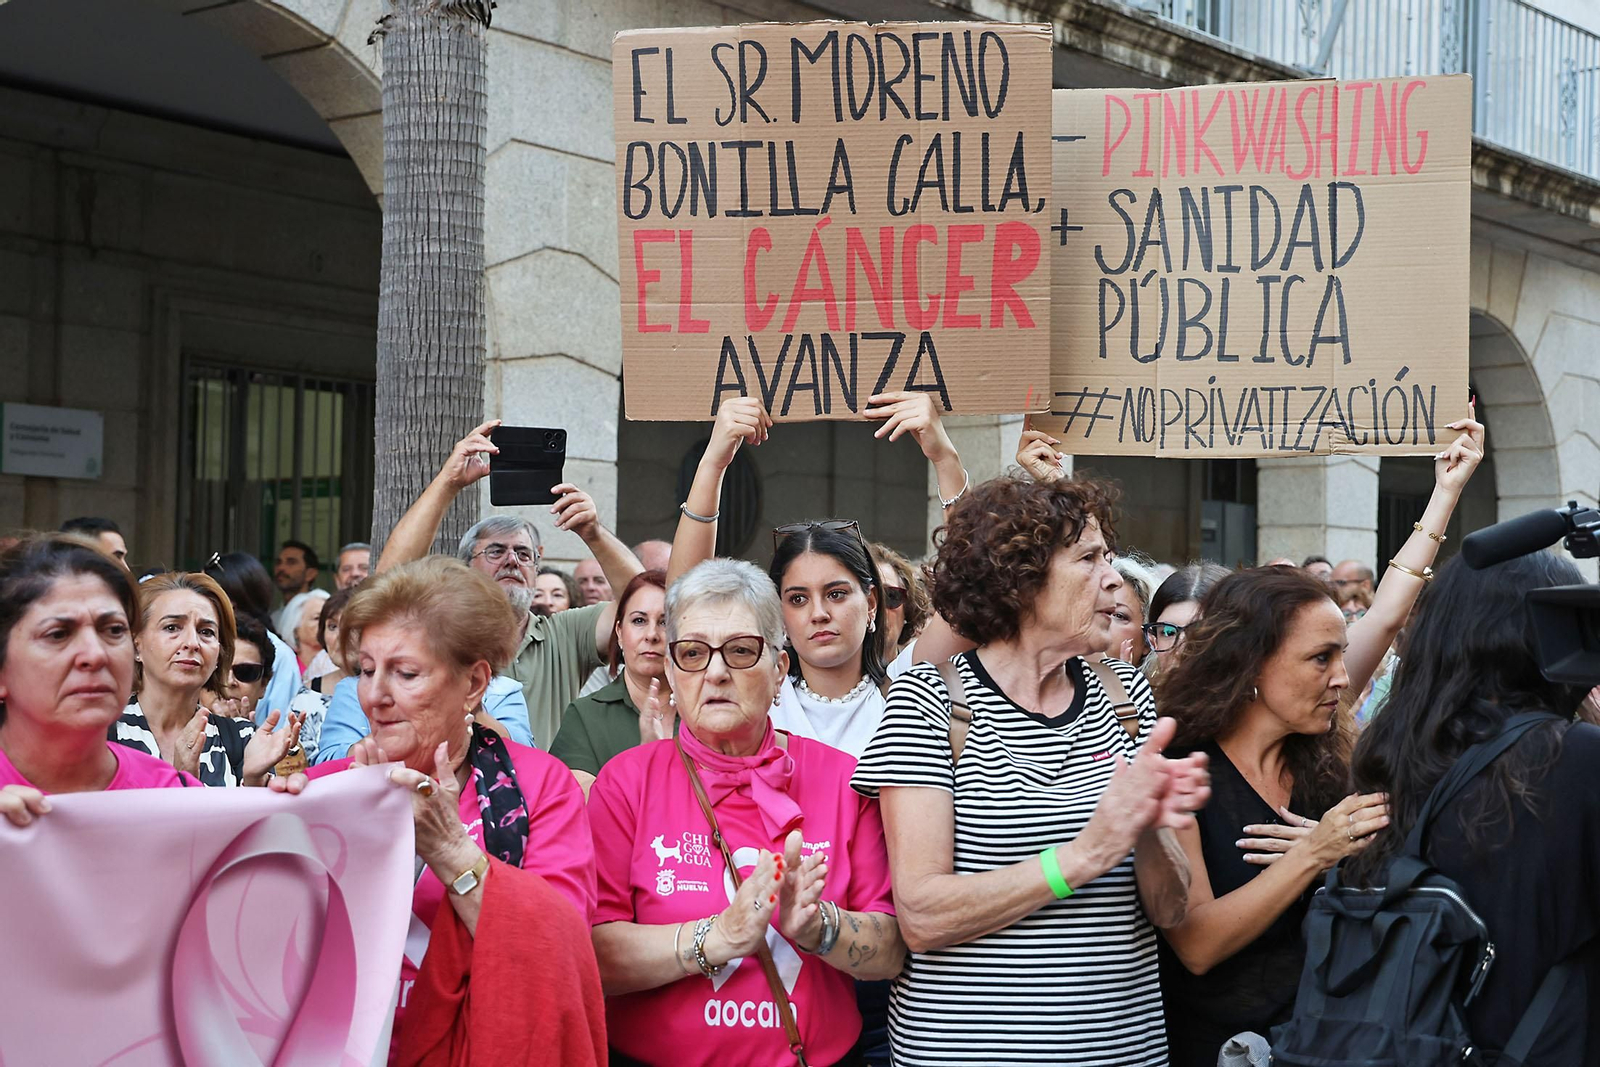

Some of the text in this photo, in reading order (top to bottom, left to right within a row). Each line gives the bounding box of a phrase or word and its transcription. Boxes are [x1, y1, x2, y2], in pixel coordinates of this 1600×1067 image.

[631, 29, 1010, 127] EL SR. MORENO
[623, 131, 1046, 220] BONILLA CALLA,
[1102, 80, 1429, 180] PINKWASHING
[1094, 181, 1366, 275] SANIDAD
[633, 215, 1041, 334] EL CÁNCER
[1099, 269, 1352, 368] PÚBLICA
[710, 331, 953, 417] AVANZA
[682, 831, 709, 846] CHI
[683, 853, 712, 868] GUA
[676, 884, 710, 892] HUELVA
